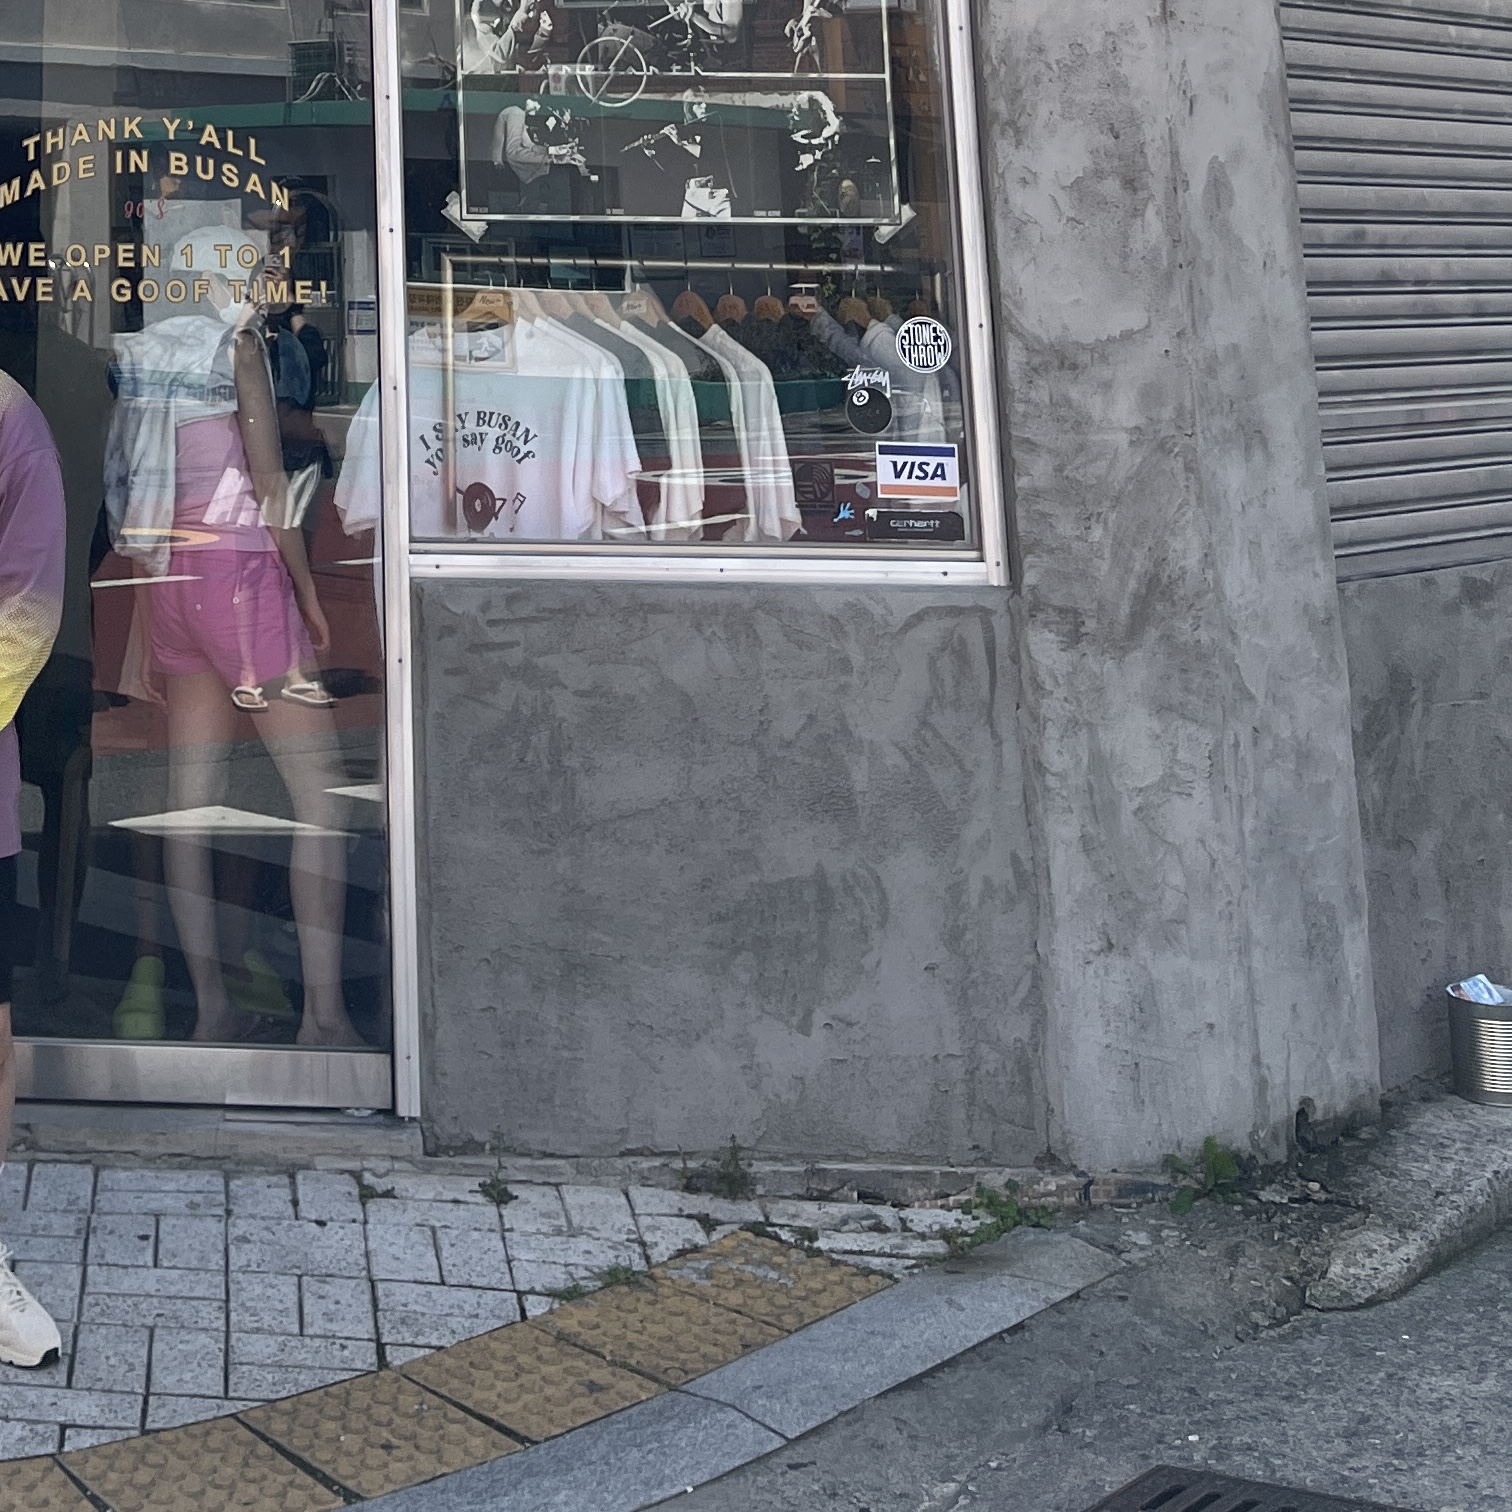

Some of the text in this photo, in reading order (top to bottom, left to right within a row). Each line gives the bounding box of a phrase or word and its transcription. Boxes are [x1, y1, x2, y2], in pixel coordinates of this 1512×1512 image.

[22, 116, 144, 162] THANK
[115, 150, 149, 174] IN
[169, 152, 291, 212] BUSAN
[66, 243, 161, 268] OPEN
[181, 245, 193, 268] 1
[213, 244, 259, 269] TO
[279, 245, 291, 268] 1
[72, 278, 93, 303] A
[111, 278, 212, 304] GOOF
[228, 279, 329, 305] TIME!
[901, 324, 945, 346] STONES
[903, 344, 946, 368] THROW
[419, 410, 538, 451] I SY BUSAN
[462, 432, 488, 451] say
[492, 433, 536, 464] goof
[889, 460, 947, 481] VISA
